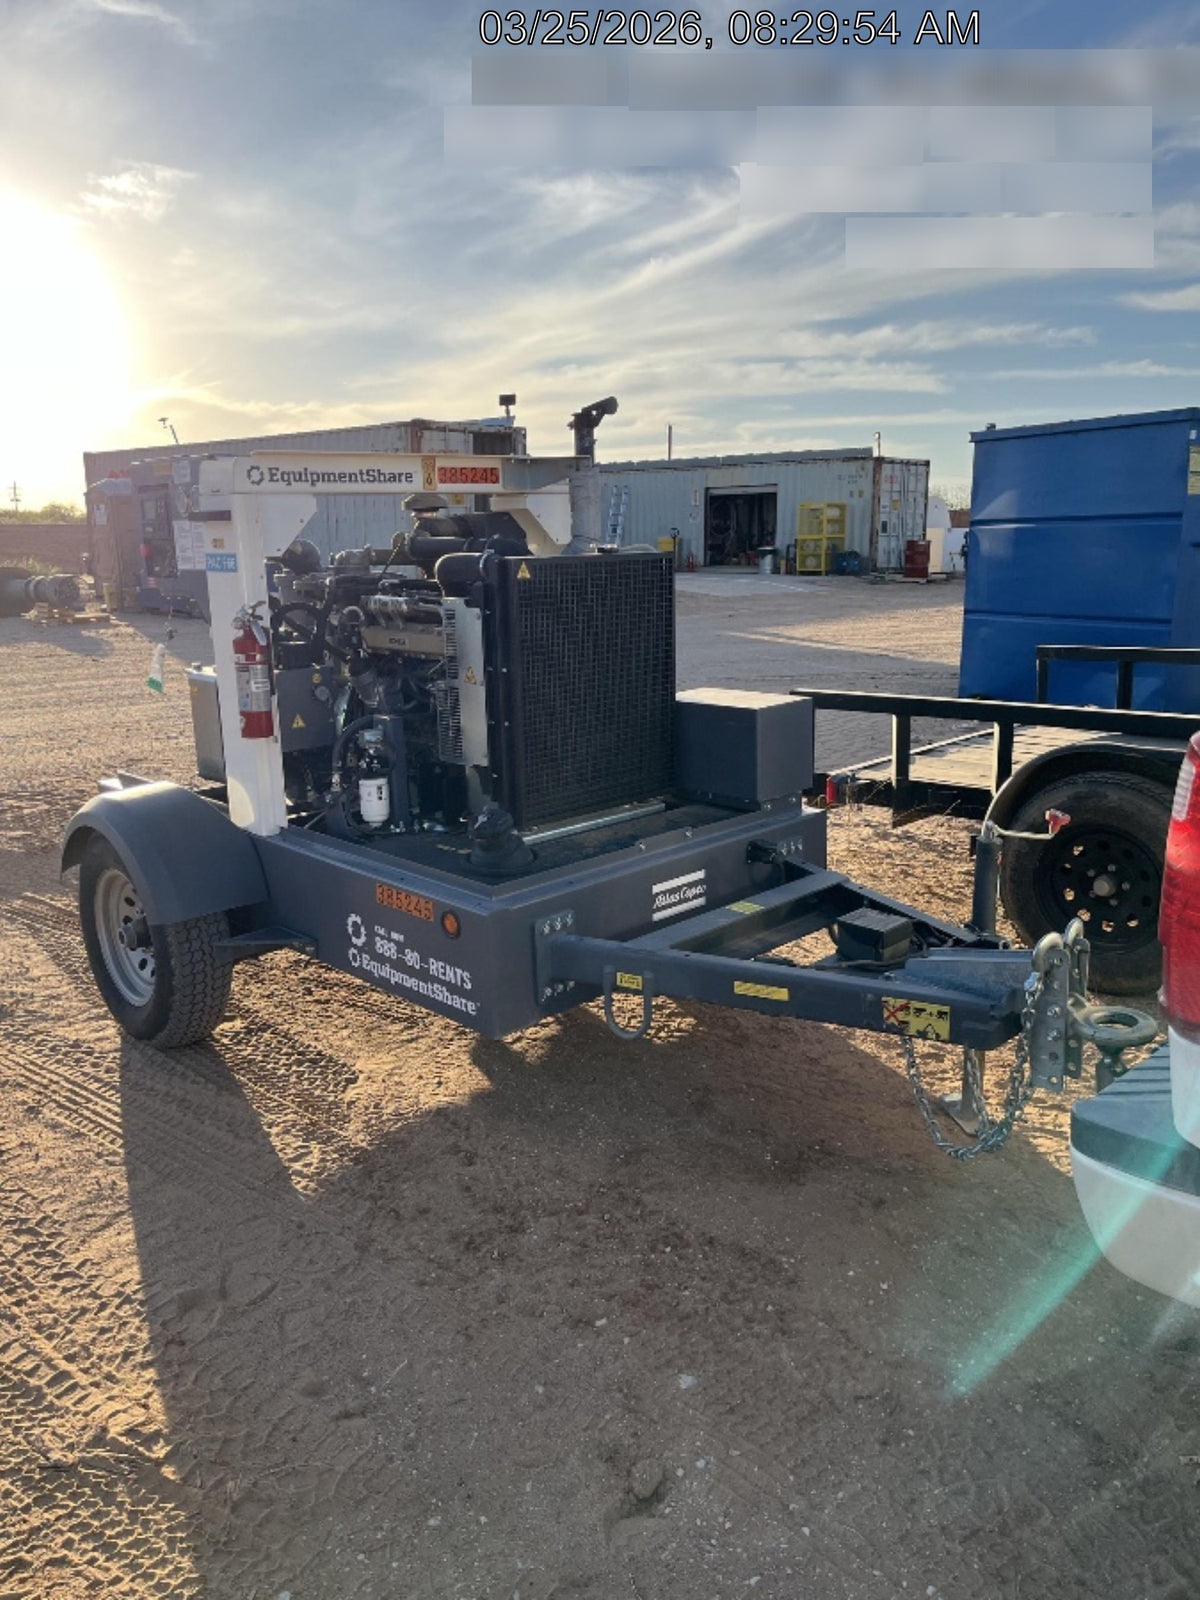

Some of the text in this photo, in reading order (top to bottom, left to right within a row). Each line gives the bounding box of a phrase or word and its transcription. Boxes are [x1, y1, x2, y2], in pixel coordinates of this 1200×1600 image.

[267, 467, 413, 486] EquipmentShare
[439, 468, 499, 484] 385245
[377, 884, 433, 921] 385245
[361, 953, 477, 1016] EquipmentShare
